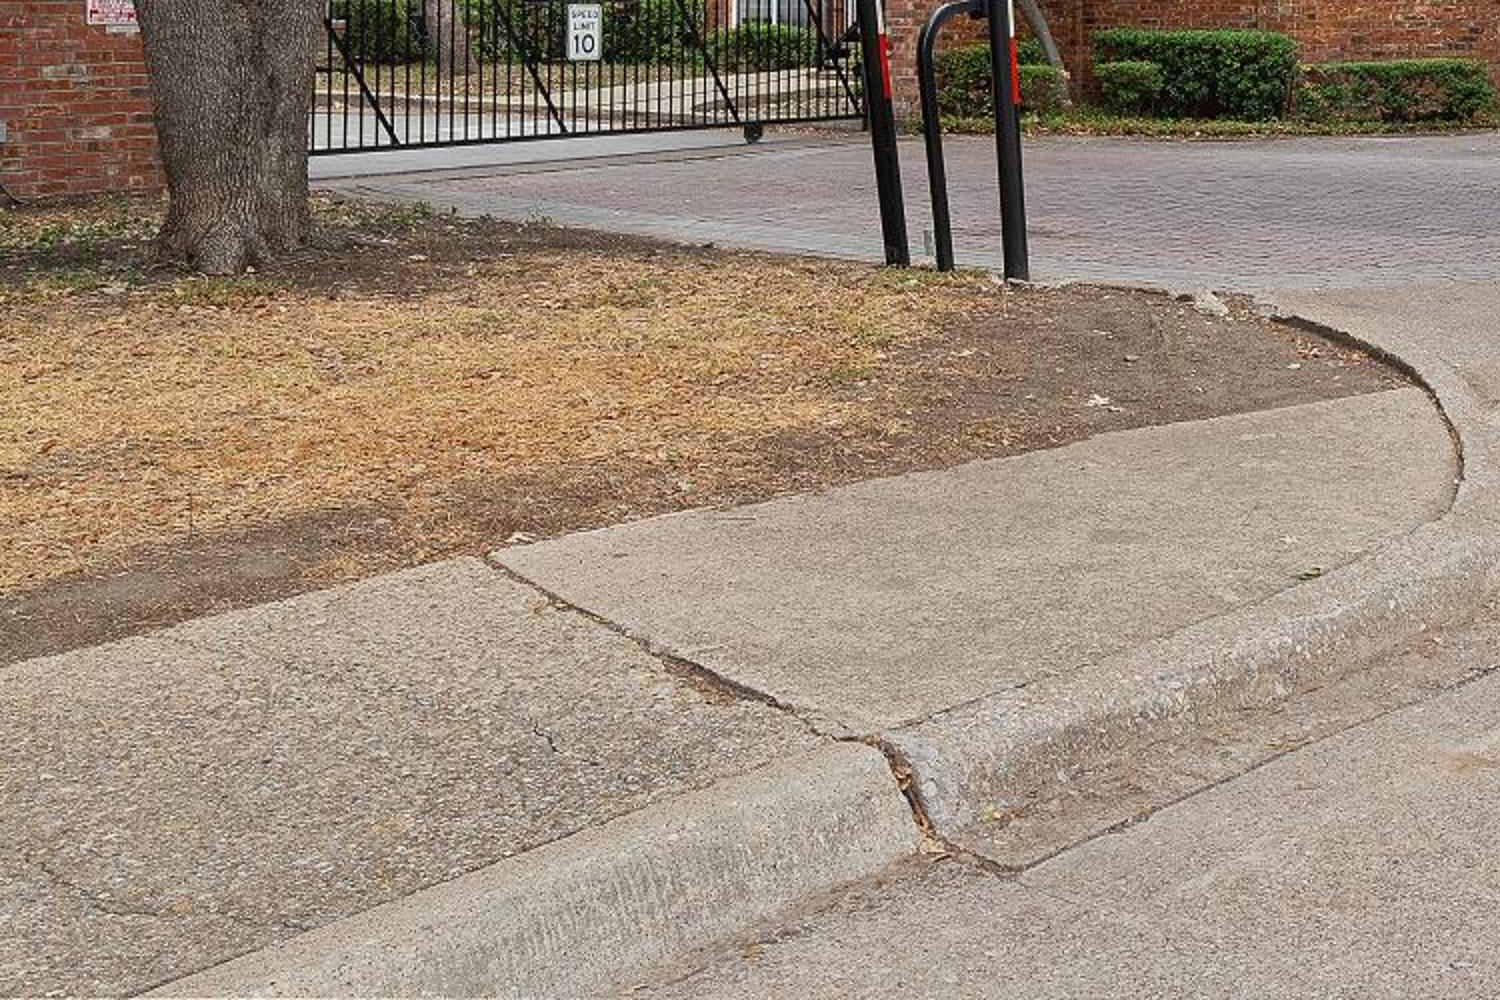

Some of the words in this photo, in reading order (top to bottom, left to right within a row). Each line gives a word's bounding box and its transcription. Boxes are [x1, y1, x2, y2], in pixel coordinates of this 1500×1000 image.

[572, 10, 599, 18] SPEED
[573, 22, 595, 30] LIMIT
[574, 34, 595, 54] 10
